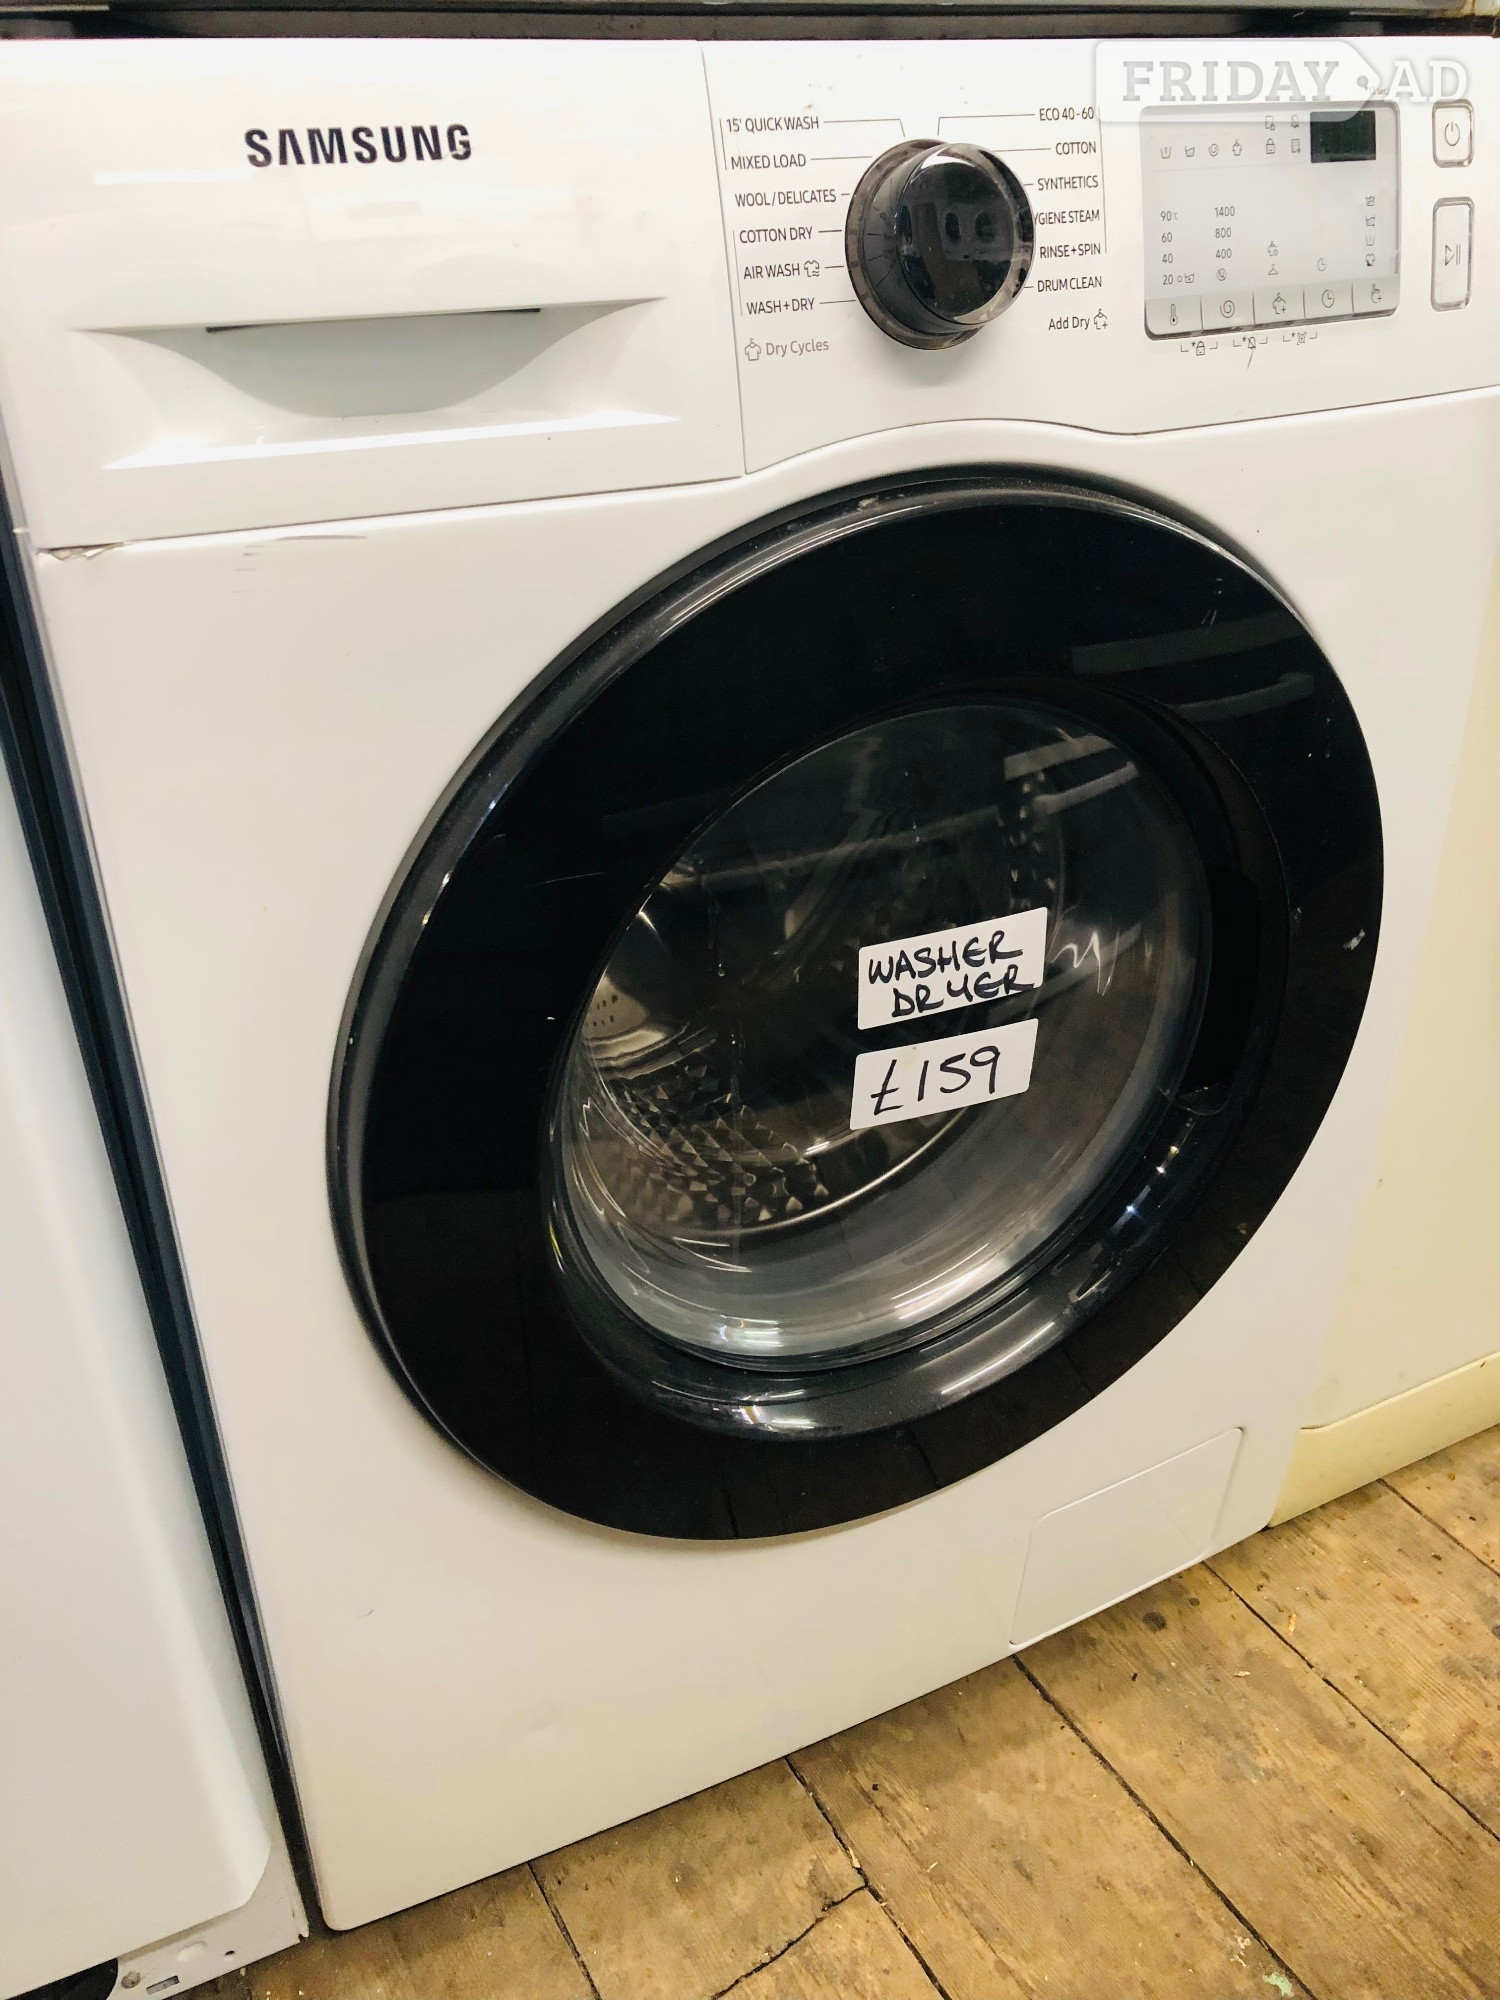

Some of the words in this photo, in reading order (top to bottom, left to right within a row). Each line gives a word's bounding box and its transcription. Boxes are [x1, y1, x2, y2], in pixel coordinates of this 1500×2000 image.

[1039, 108, 1059, 121] ECO
[726, 118, 742, 132] 15'
[745, 117, 783, 134] QUICK
[783, 116, 819, 130] WASH
[244, 123, 472, 168] SAMSUNG
[1055, 141, 1096, 155] COTTON
[731, 155, 770, 170] MIXED
[774, 154, 806, 169] LOAD
[1037, 175, 1099, 191] SYNTHETICS
[1034, 211, 1067, 225] YGIENE
[1068, 209, 1100, 223] STEAM
[1215, 206, 1236, 217] 1400
[739, 228, 787, 244] COTTON
[790, 227, 813, 241] DRY
[1161, 232, 1173, 243] 60
[1215, 227, 1232, 238] 800
[1162, 253, 1174, 264] 40
[1215, 248, 1232, 259] 400
[743, 266, 764, 280] AIR
[766, 263, 800, 278] WASH
[1163, 274, 1174, 285] 20
[1037, 278, 1068, 293] DRUM
[1069, 276, 1102, 290] CLEAN
[1048, 316, 1069, 330] Add
[1072, 315, 1090, 330] Dry
[766, 341, 788, 358] Dry
[790, 339, 829, 356] Cycles
[868, 930, 1023, 985] WASHER
[891, 964, 1036, 1018] DRYER
[870, 1045, 1000, 1116] £159
